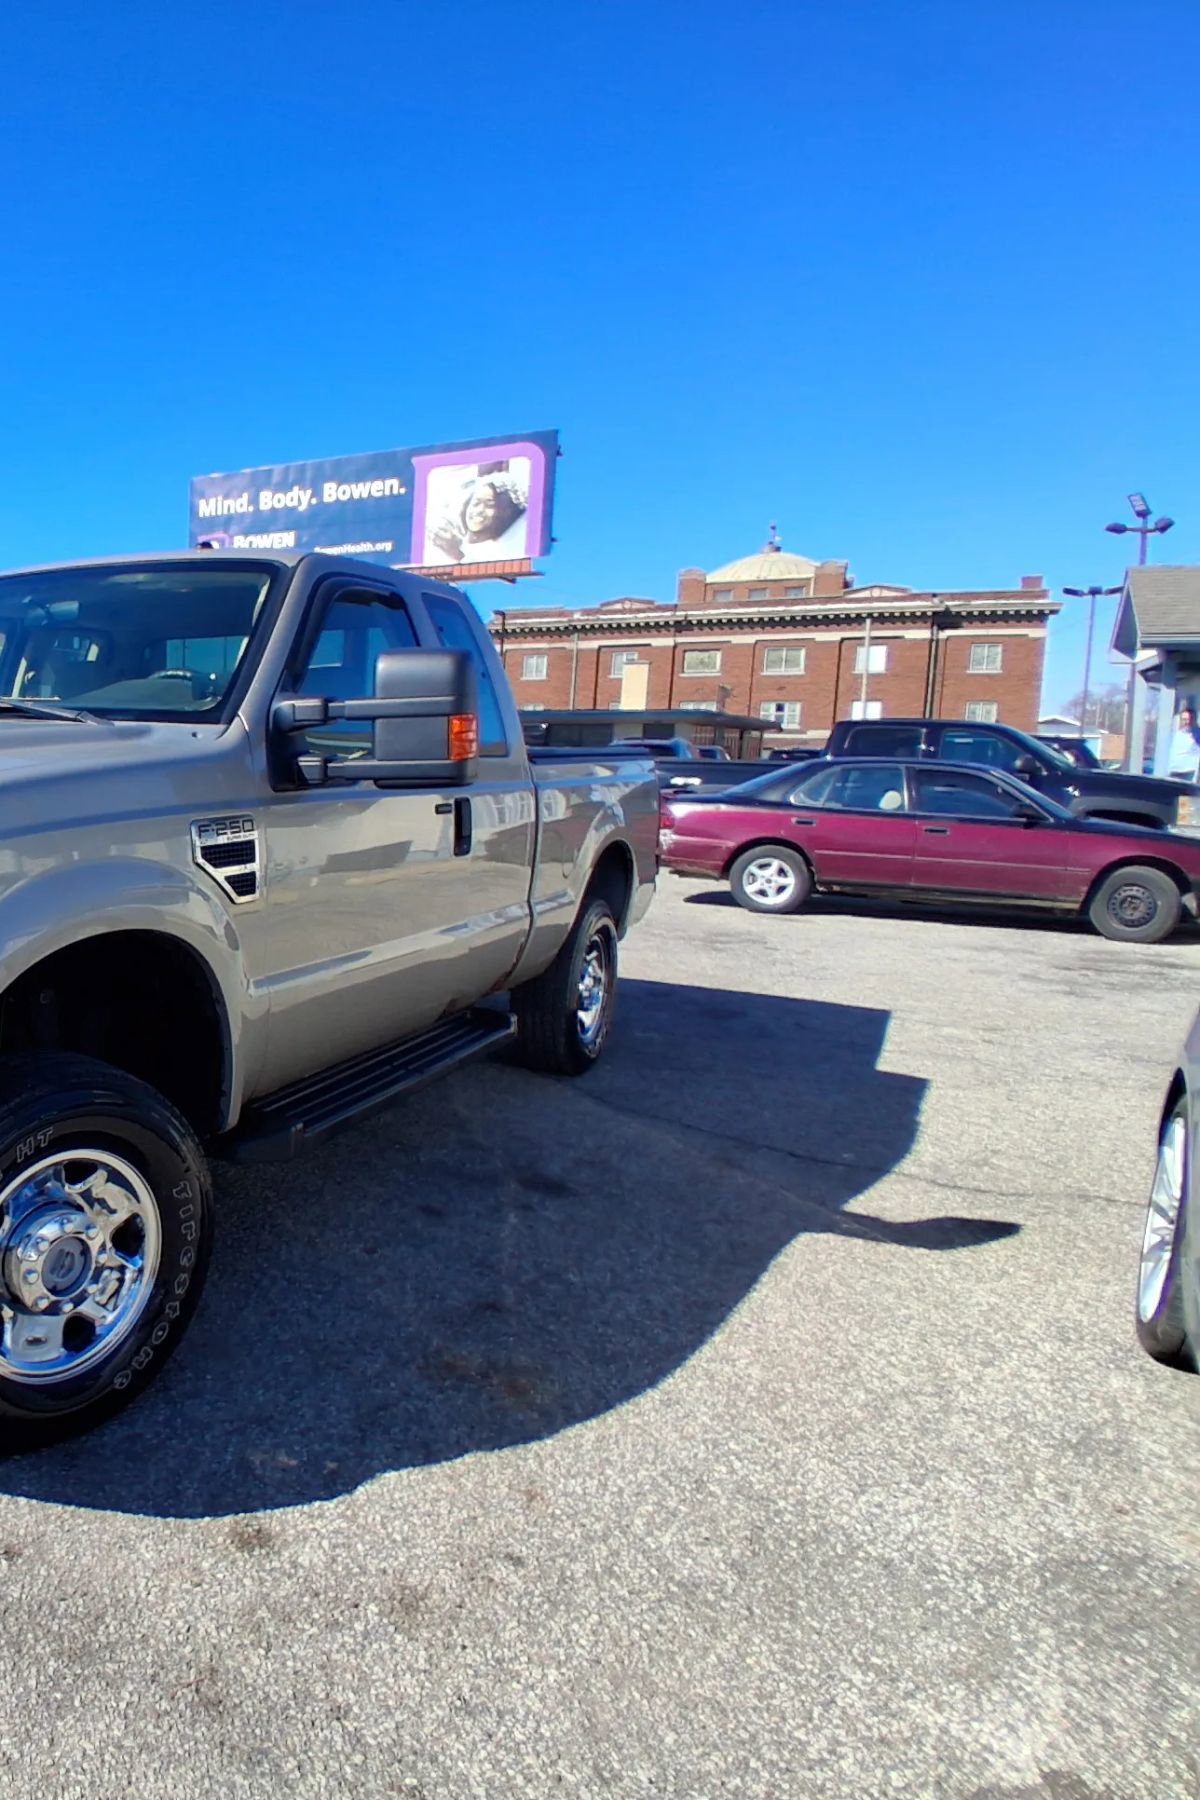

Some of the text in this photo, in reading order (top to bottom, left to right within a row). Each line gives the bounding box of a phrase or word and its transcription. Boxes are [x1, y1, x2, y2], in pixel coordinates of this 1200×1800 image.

[198, 478, 406, 518] Mind. Body. Bowen.
[233, 531, 295, 549] BOWEN
[198, 819, 255, 839] F-250
[15, 1127, 54, 1164] HT
[113, 1180, 196, 1390] Firestone
